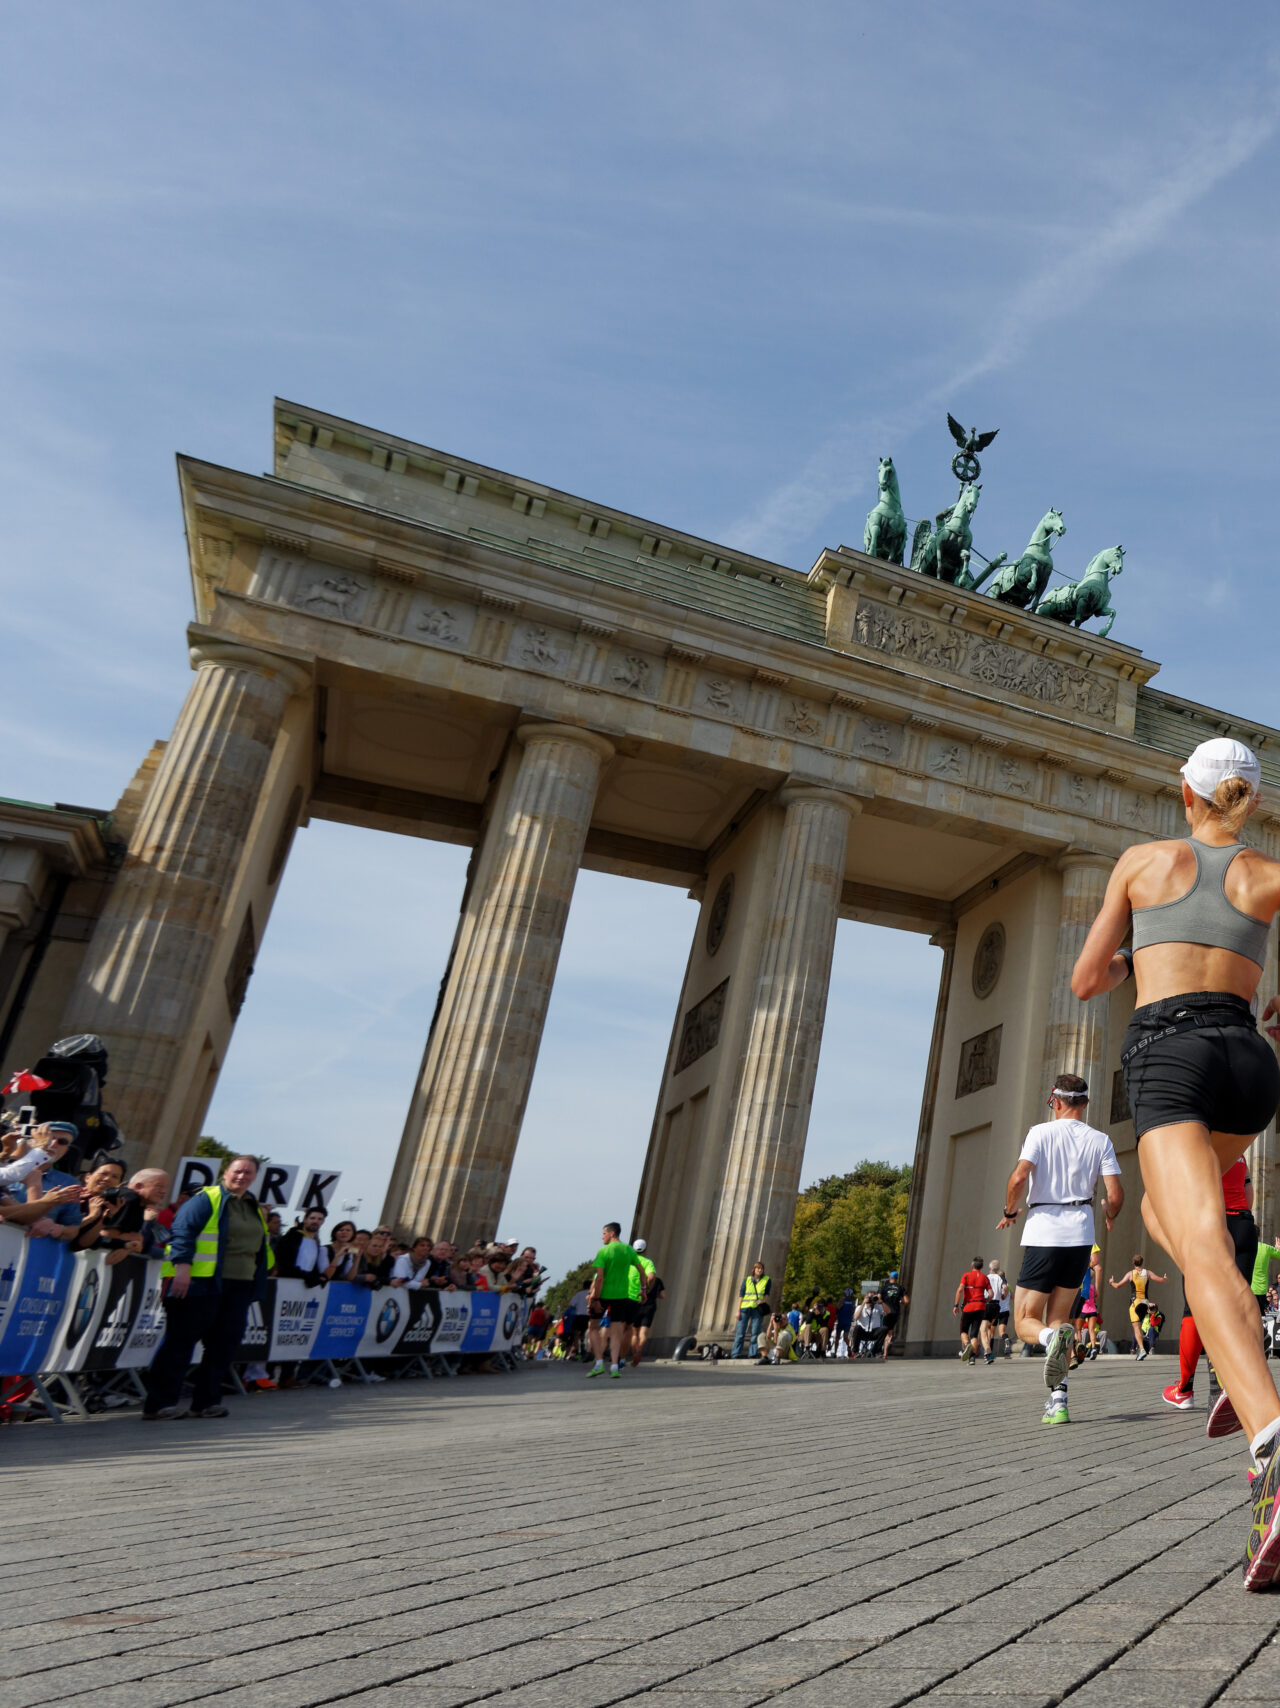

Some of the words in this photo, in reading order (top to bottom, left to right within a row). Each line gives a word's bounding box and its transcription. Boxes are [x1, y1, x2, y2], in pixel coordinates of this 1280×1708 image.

[280, 1300, 305, 1317] BMW
[278, 1319, 300, 1332] BERLIN
[276, 1333, 312, 1346] MARATHON
